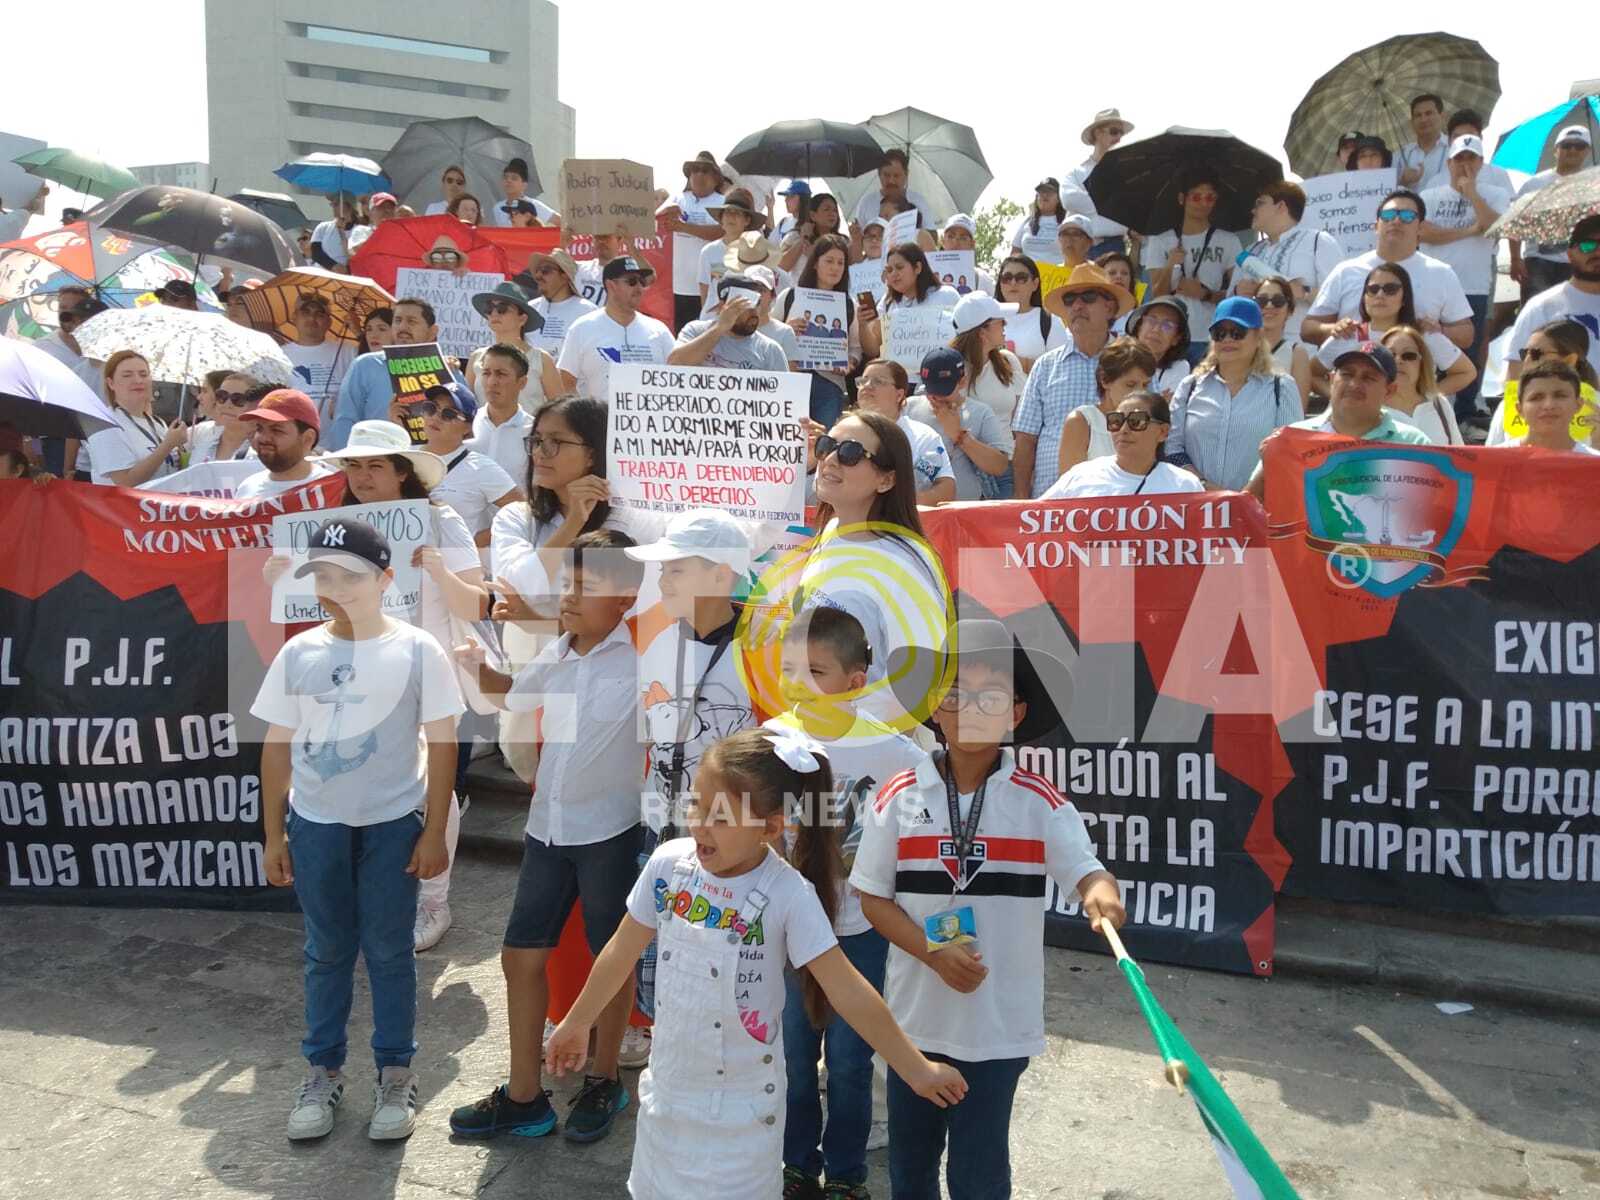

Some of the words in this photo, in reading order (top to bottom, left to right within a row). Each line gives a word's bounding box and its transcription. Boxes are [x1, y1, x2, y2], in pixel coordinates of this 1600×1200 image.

[1307, 191, 1333, 204] xico
[641, 369, 685, 389] DESDE
[688, 373, 715, 390] QUE
[717, 374, 742, 392] SOY
[616, 391, 633, 412] HE
[727, 398, 780, 418] COMIDO
[784, 400, 793, 418] E
[615, 415, 641, 433] IDO
[647, 417, 657, 433] A
[663, 416, 746, 439] DORMIRME
[749, 422, 772, 441] SIN
[776, 423, 806, 442] VER
[613, 437, 624, 455] A
[627, 438, 644, 456] MI
[749, 444, 805, 465] PORQUE
[617, 460, 688, 481] TRABAJA
[696, 463, 796, 485] DEFENDIENDO
[298, 484, 327, 511] 11
[640, 482, 672, 502] TUS
[680, 485, 757, 506] DERECHOS
[1018, 500, 1188, 535] SECCIÓN
[1199, 500, 1232, 529] 11
[1003, 536, 1251, 569] MONTERREY
[64, 637, 172, 686] P.J.F.
[1494, 620, 1600, 675] EXIG
[1313, 690, 1419, 743] CESE
[1434, 698, 1463, 746] A
[1479, 699, 1533, 749] LA
[155, 712, 239, 763] LOS
[1177, 752, 1228, 802] AL
[1323, 754, 1440, 810] P.J.F.
[58, 774, 260, 827] HUMANOS
[1166, 817, 1216, 868] LA
[6, 840, 80, 887] LOS
